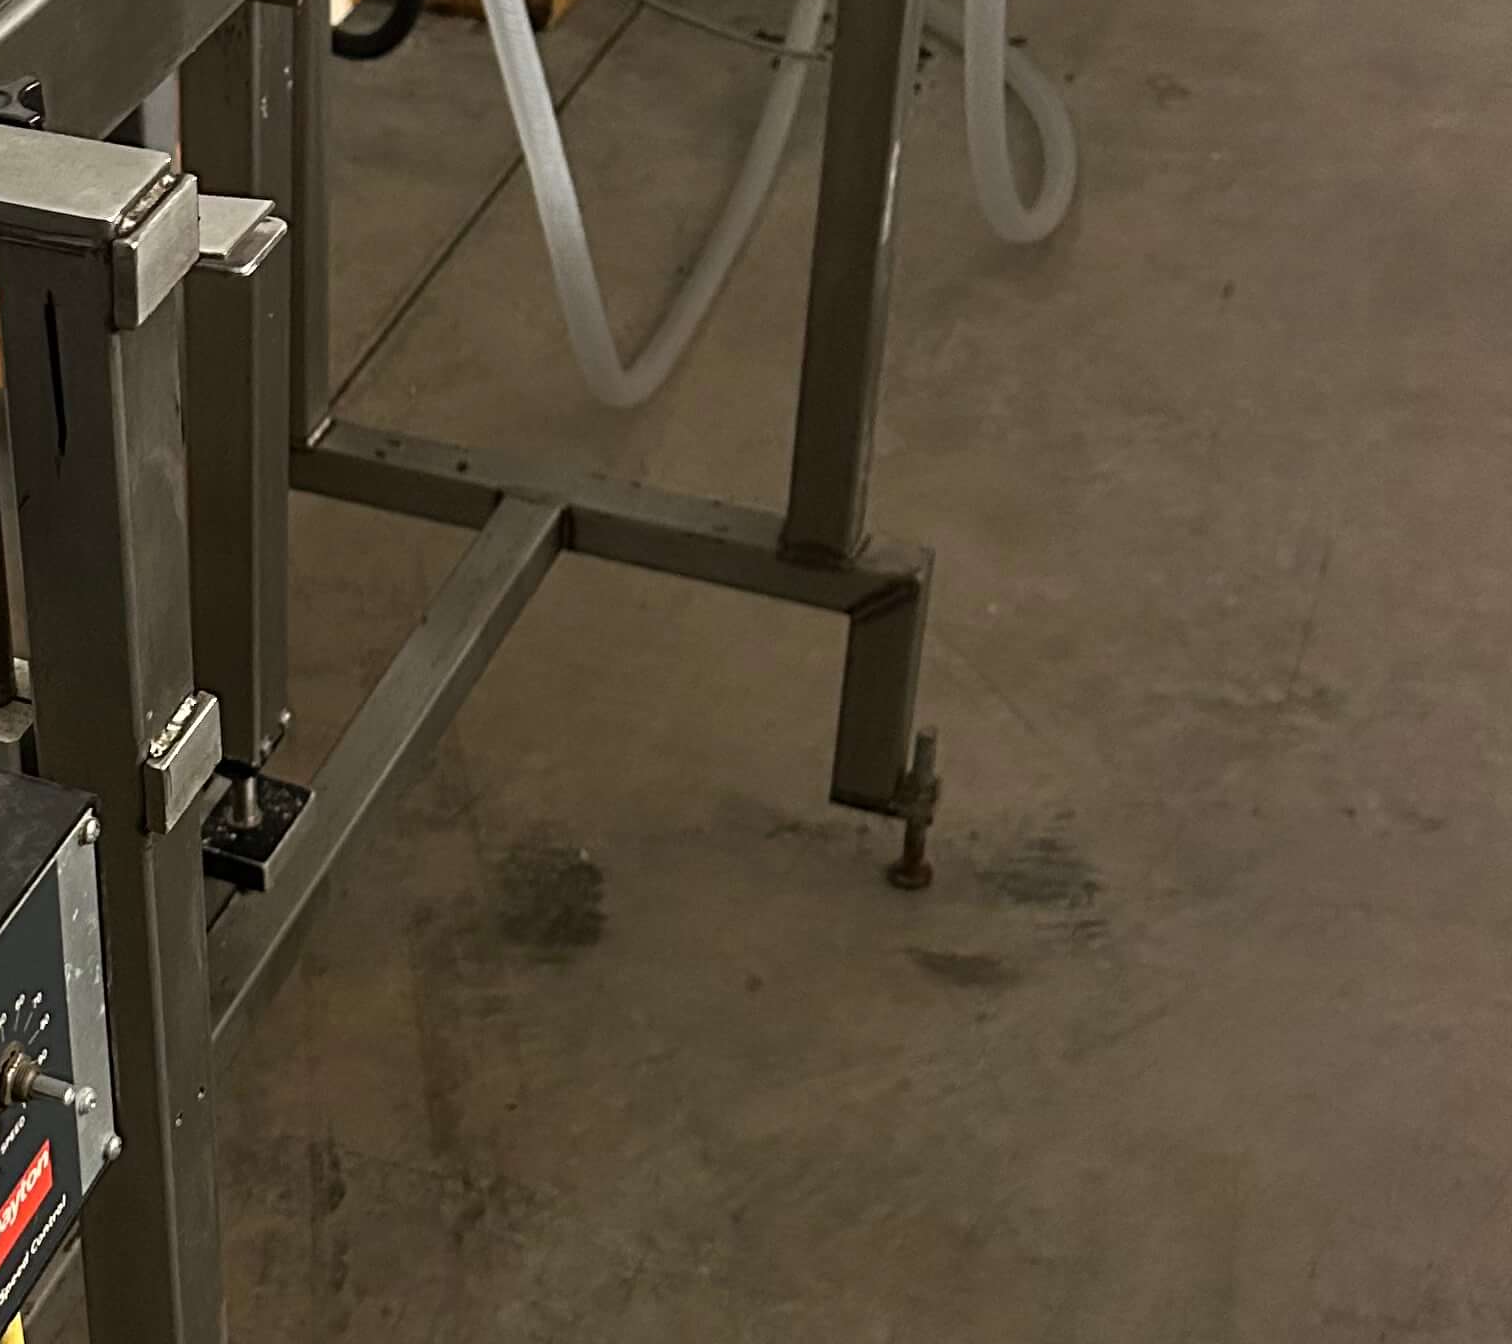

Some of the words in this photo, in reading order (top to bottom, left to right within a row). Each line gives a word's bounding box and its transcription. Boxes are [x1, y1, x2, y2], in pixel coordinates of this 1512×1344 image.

[0, 1115, 26, 1155] SPEED
[0, 1249, 30, 1306] Speed
[30, 1192, 67, 1255] Control
